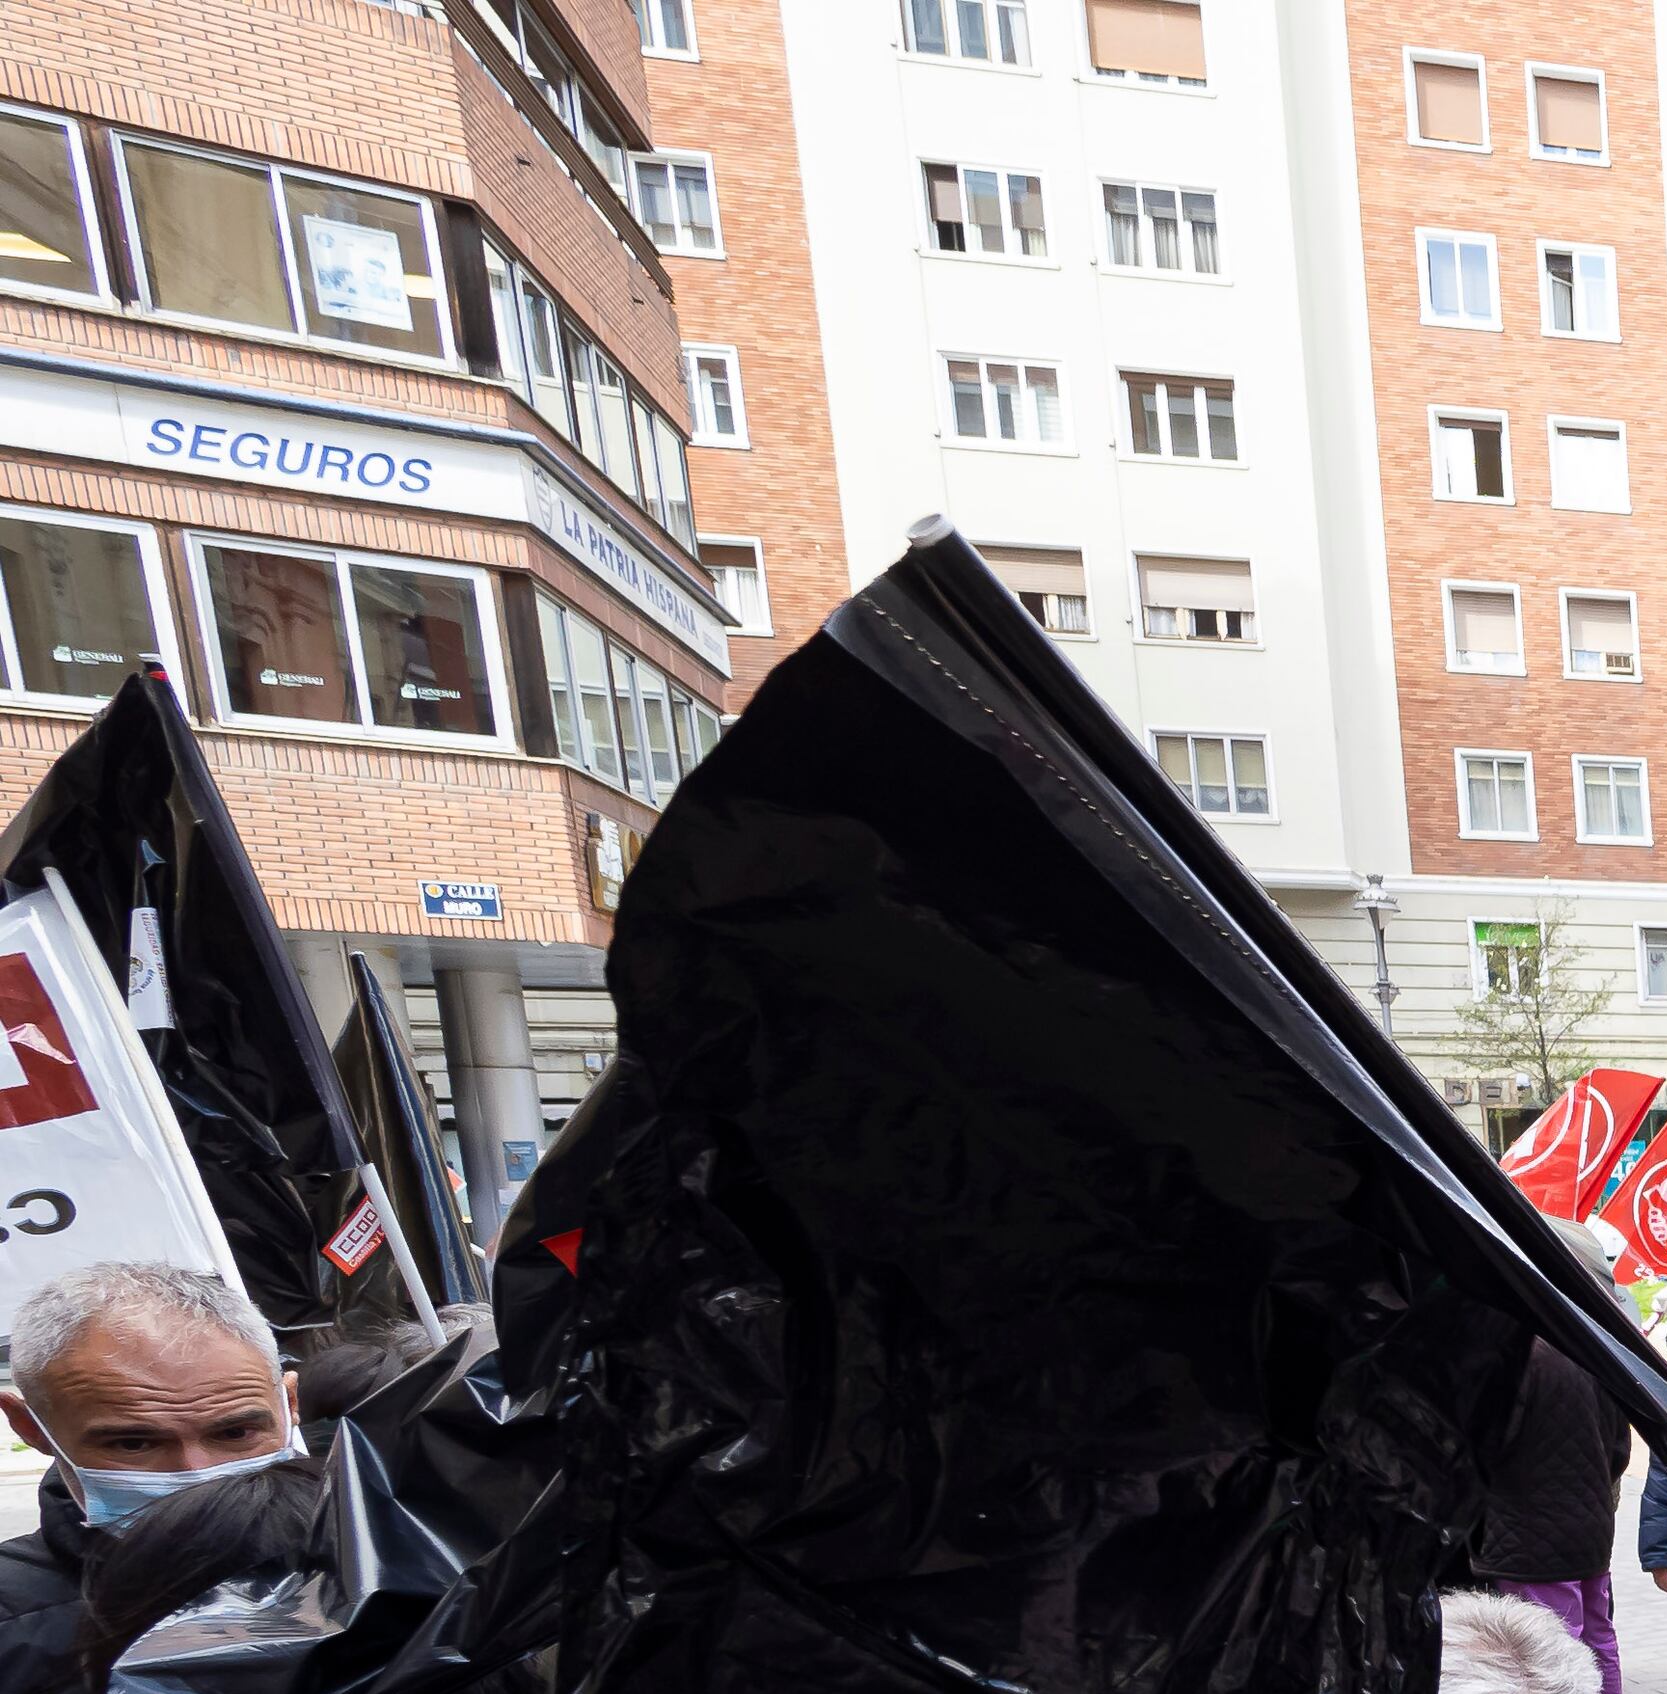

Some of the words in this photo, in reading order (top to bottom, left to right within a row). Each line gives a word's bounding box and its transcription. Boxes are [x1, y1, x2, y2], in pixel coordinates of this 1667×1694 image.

[146, 418, 433, 493] SEGUROS
[560, 499, 584, 548] LA
[587, 522, 640, 593] PATRIA
[643, 569, 698, 640] HISPANA
[442, 900, 483, 916] MURO
[446, 885, 496, 900] CALLE
[337, 1208, 379, 1255] CCOO
